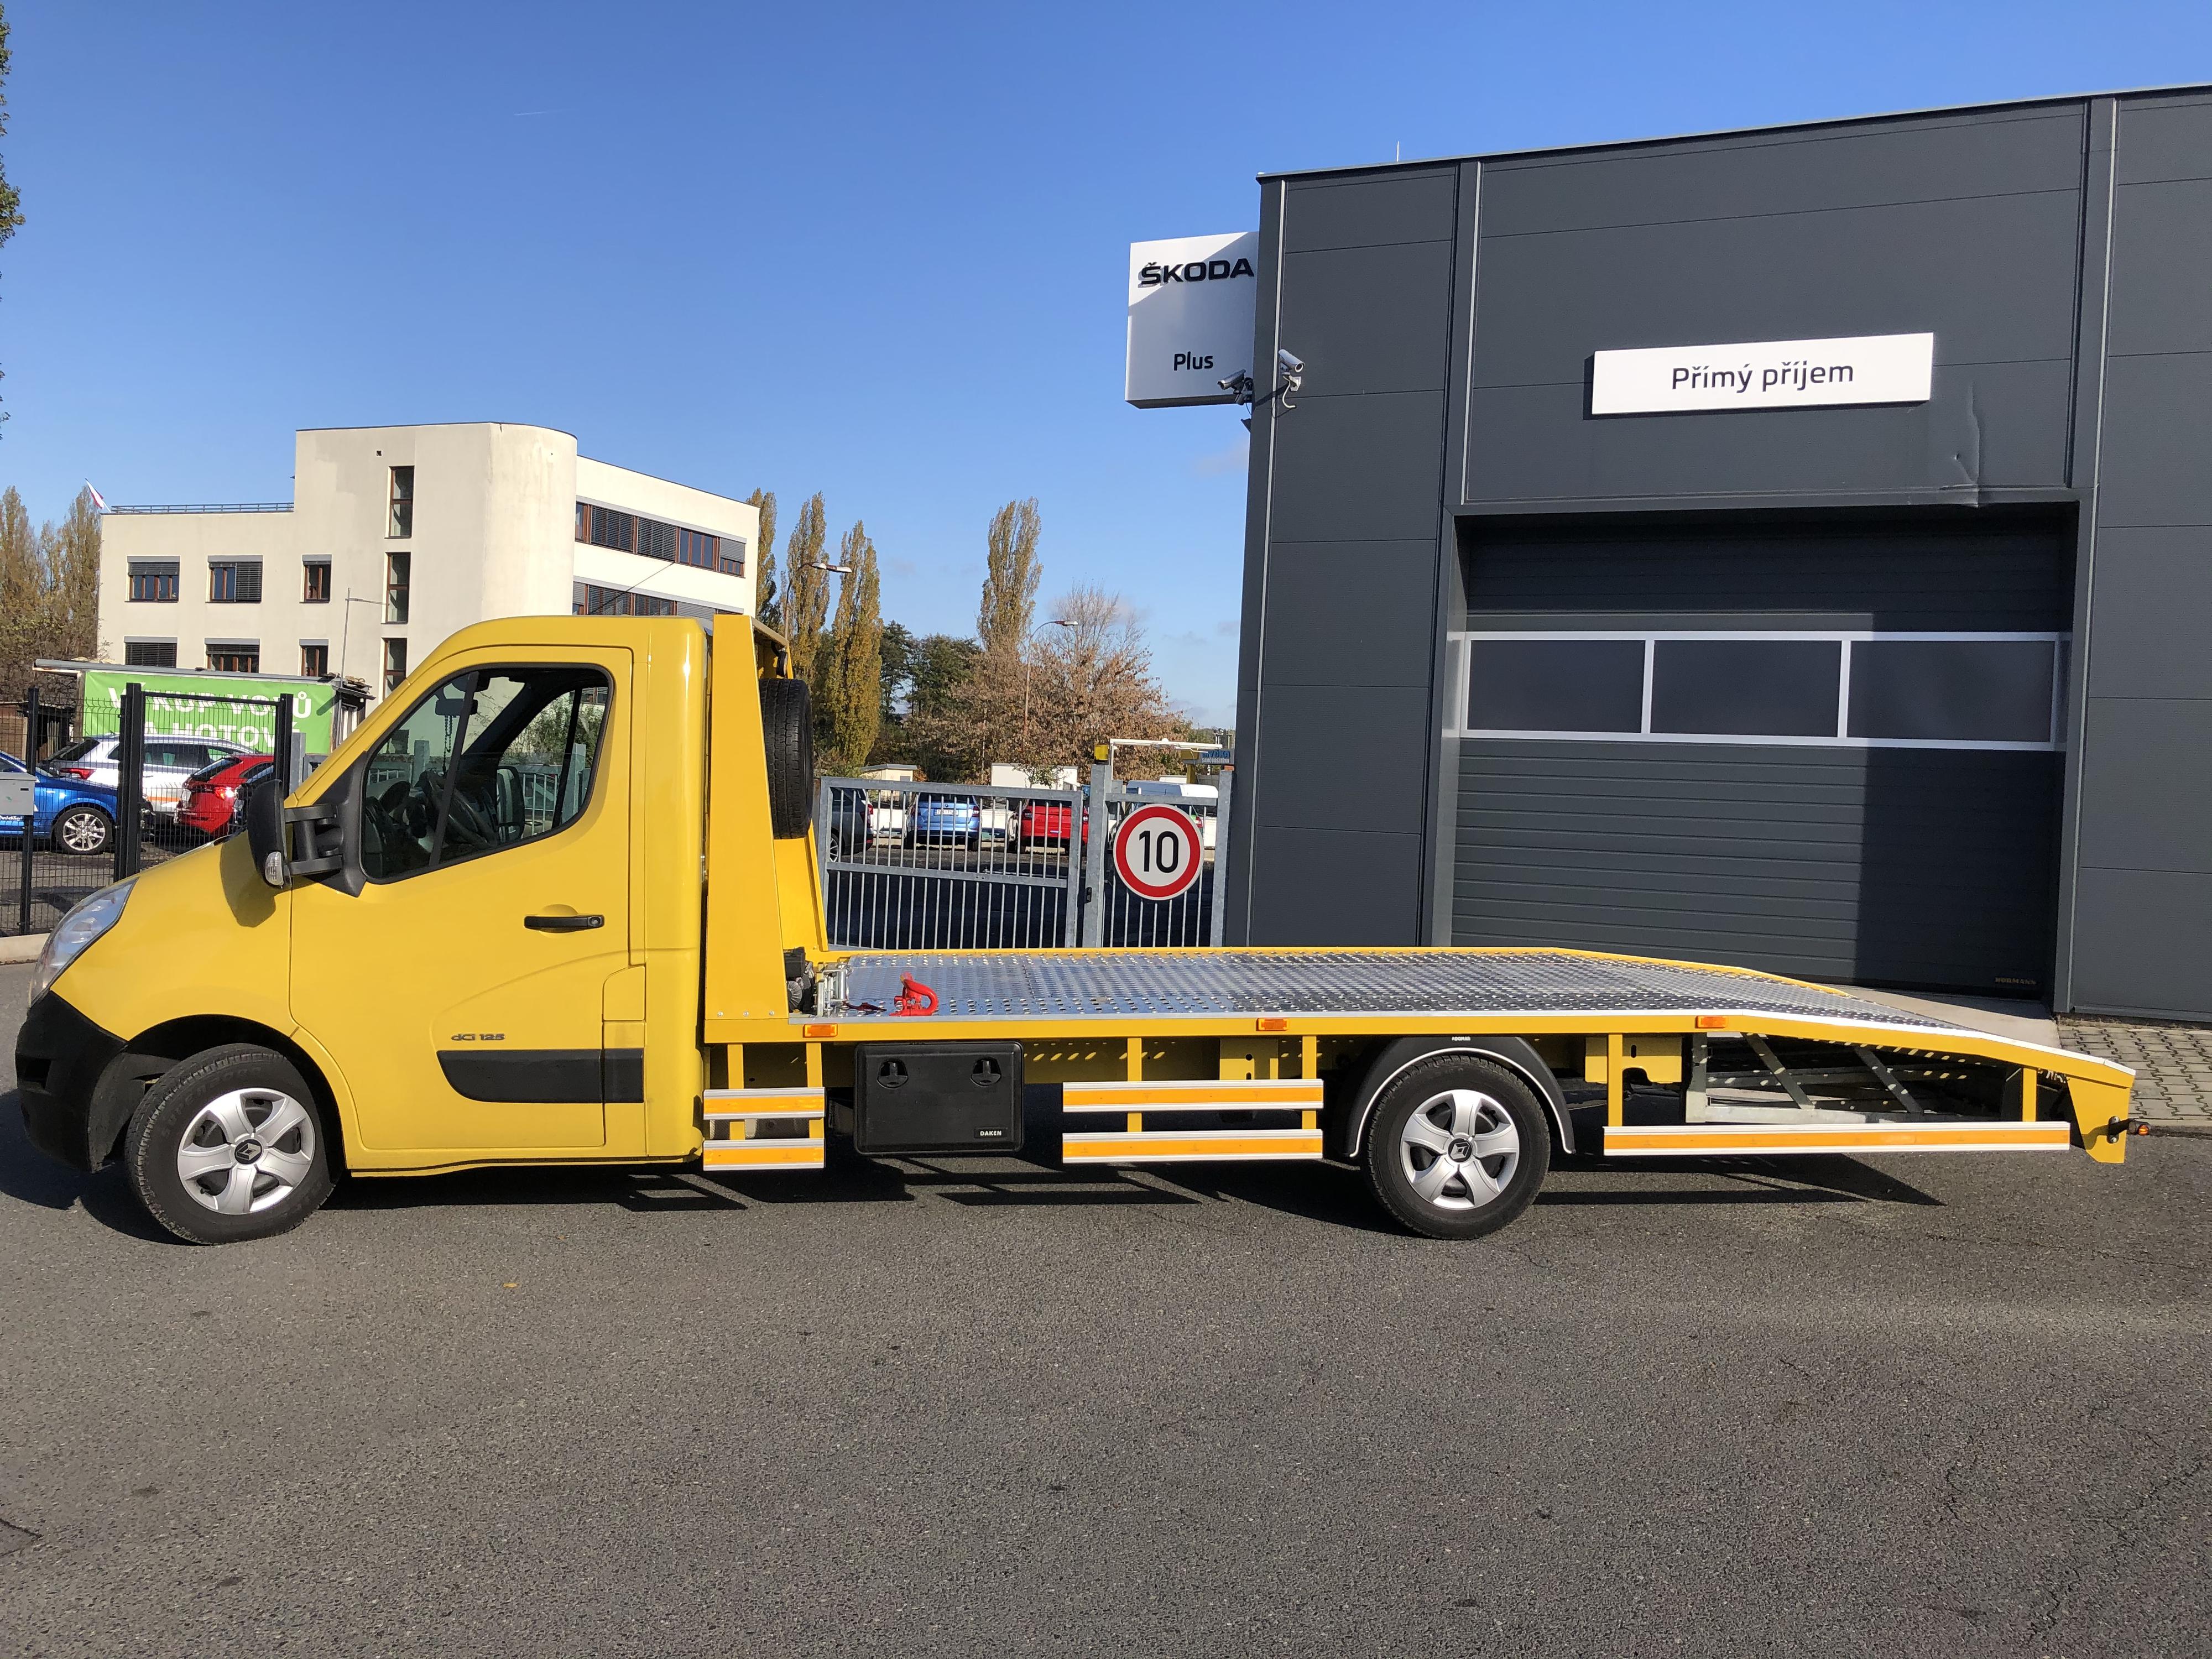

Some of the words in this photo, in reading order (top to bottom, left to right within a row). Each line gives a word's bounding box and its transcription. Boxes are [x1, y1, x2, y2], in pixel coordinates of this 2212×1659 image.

[1141, 258, 1255, 285] ŠKODA
[1173, 351, 1214, 371] Plus
[1672, 363, 1753, 393] Přímý
[1762, 360, 1854, 392] příjem
[108, 682, 215, 713] VKUP
[1139, 830, 1179, 873] 10
